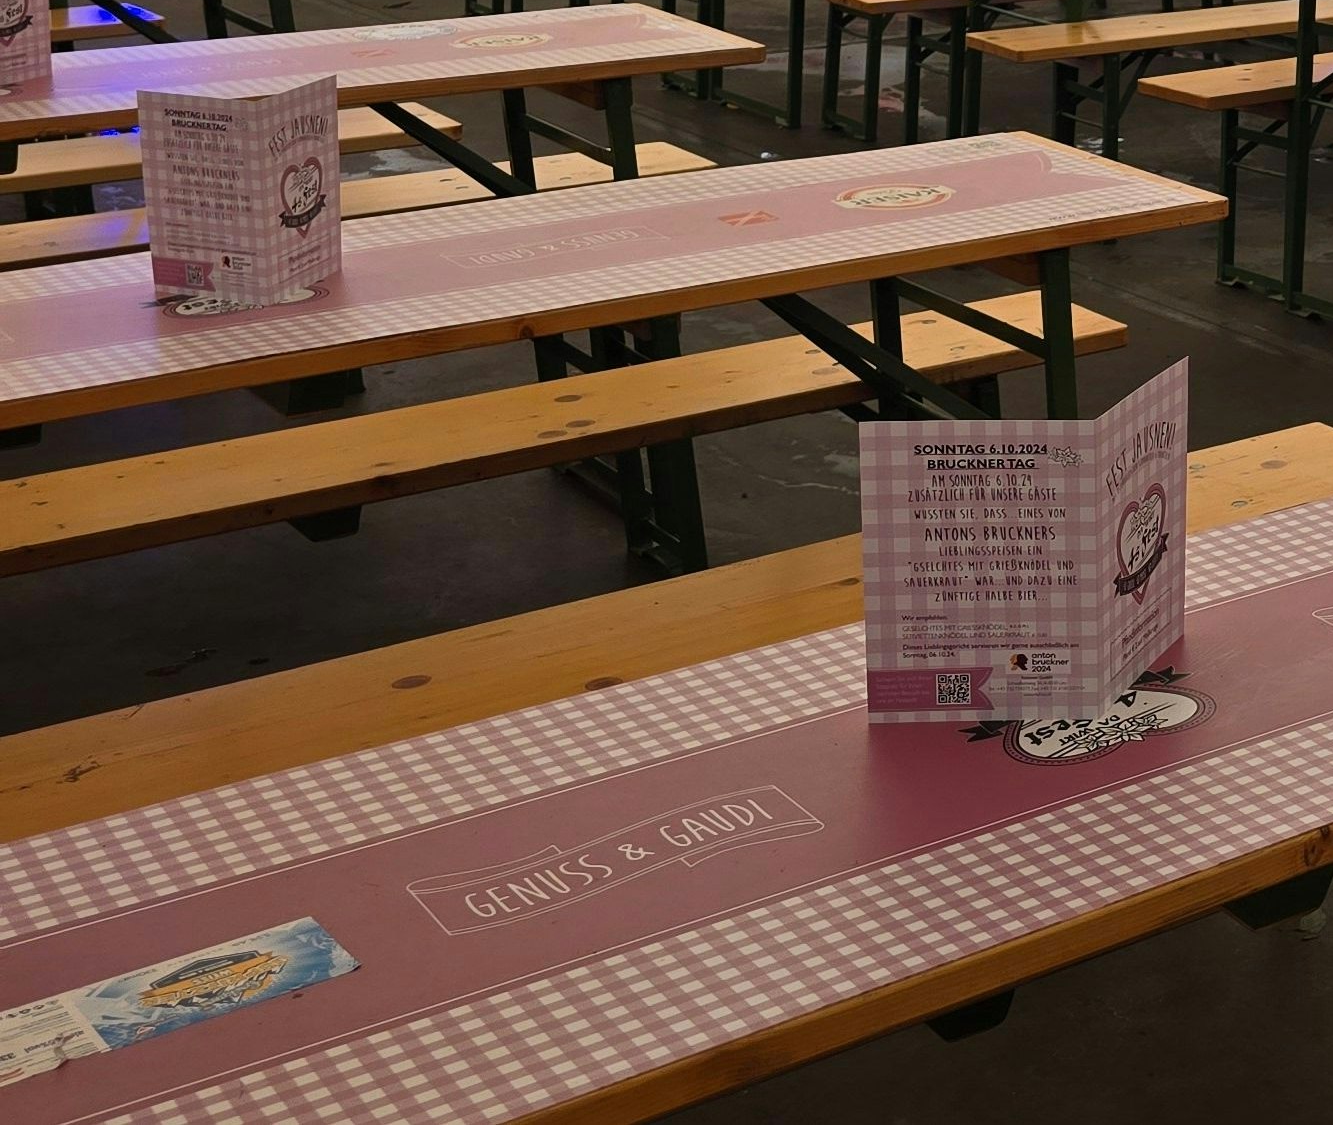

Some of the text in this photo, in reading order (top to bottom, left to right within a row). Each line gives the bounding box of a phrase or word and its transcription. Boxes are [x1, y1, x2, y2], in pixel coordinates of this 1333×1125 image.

[164, 107, 201, 119] SONNTAG
[268, 126, 287, 158] FEST
[914, 443, 1048, 455] SONNTAG 6.10.2024
[1105, 447, 1127, 497] FEST
[1132, 421, 1177, 463] JAUSNEN!
[931, 474, 946, 488] AM
[950, 474, 991, 487] SONNTAG
[907, 487, 1057, 503] ZUSÄTZLICH FÜR UNSERE GÄSTE
[914, 508, 957, 520] WUSSTEN
[1049, 507, 1066, 518] VON
[924, 525, 1056, 542] ANTONS BRUCKNERS
[939, 545, 1043, 557] LIEBLINGSSPEISEN EIN
[968, 561, 985, 571] MIT
[1056, 560, 1074, 570] UND
[1027, 575, 1052, 586] DAZU
[1057, 575, 1078, 586] EINE
[935, 590, 981, 603] ZÜNFTIGE
[985, 590, 1014, 602] HALBE
[1031, 658, 1069, 666] bruckner
[1031, 665, 1051, 673] 2024
[463, 798, 776, 921] GENUSS & GAUDI
